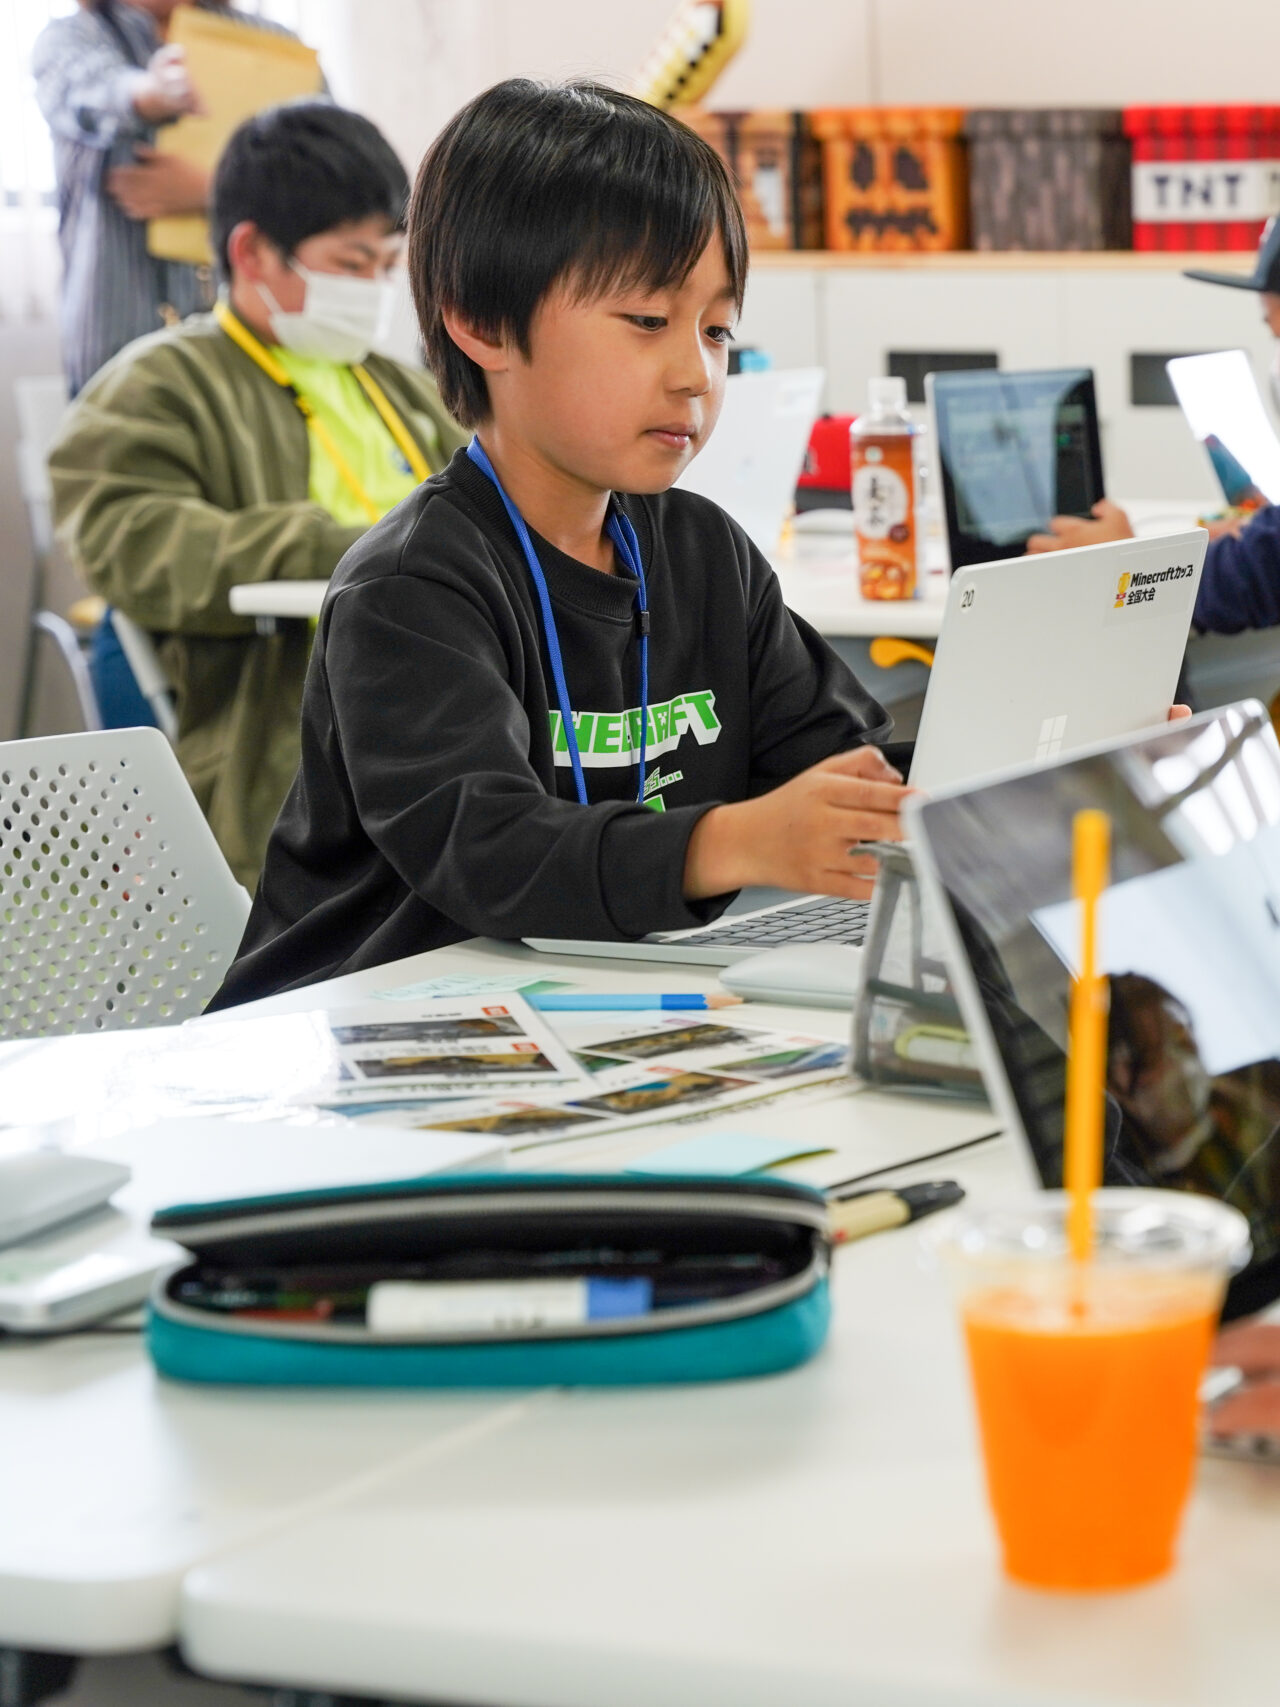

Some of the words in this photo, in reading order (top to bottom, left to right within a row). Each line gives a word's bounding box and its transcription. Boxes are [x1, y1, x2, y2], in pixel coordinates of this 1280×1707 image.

[1155, 173, 1240, 206] TNT
[962, 589, 975, 608] 20
[1126, 587, 1156, 605] 全国大会
